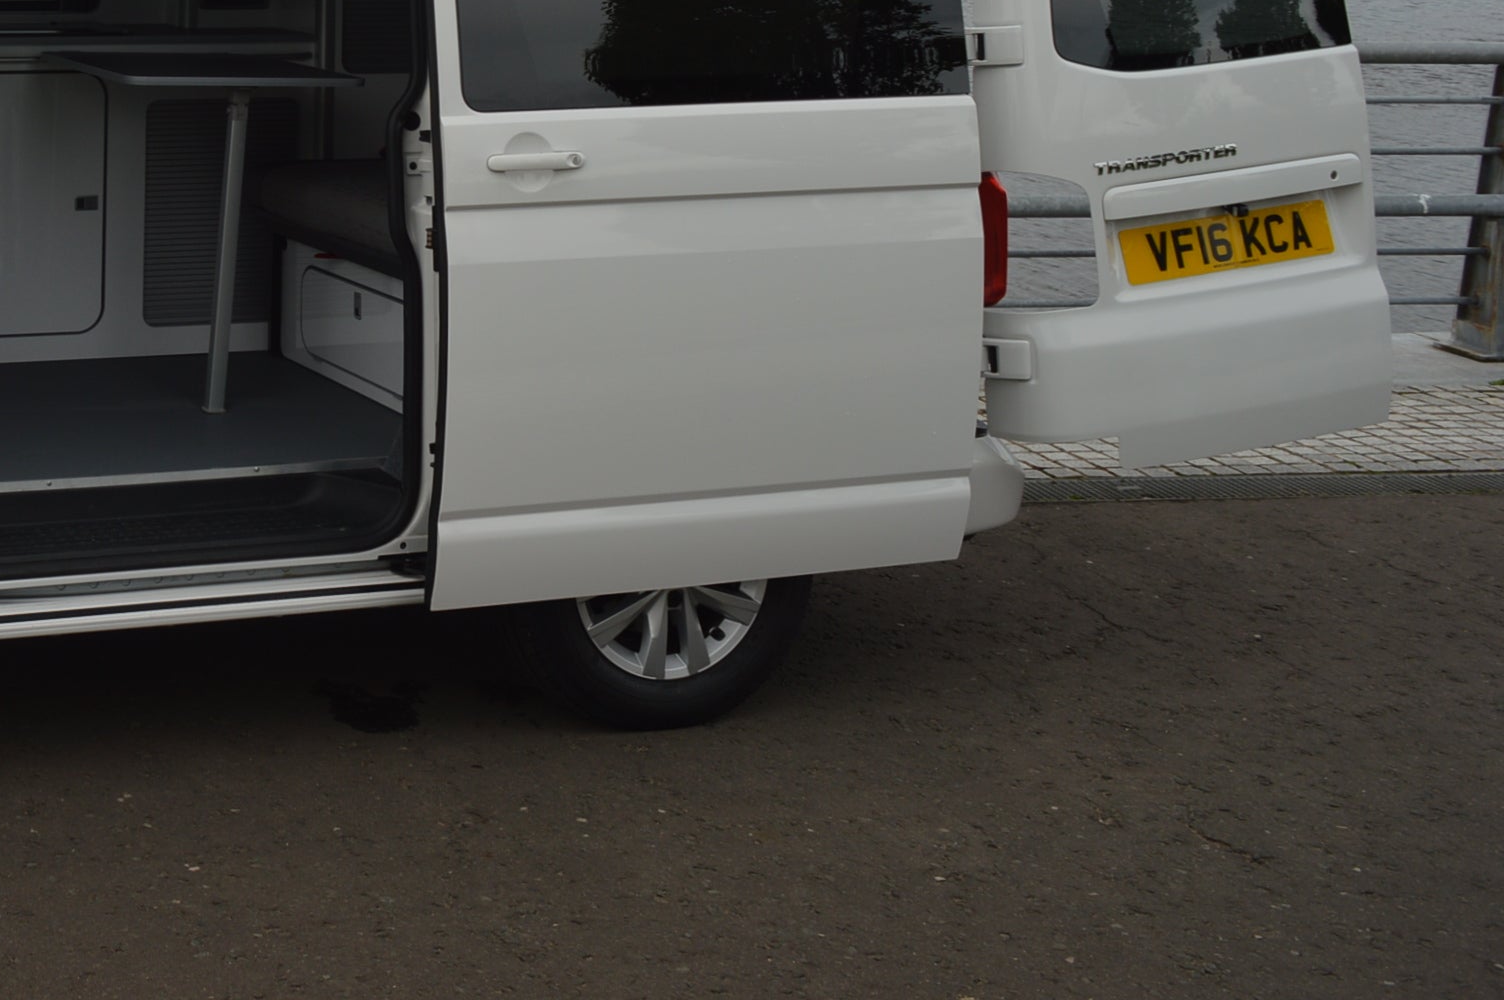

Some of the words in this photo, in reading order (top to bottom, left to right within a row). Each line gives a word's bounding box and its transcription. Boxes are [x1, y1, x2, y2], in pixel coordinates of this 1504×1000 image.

[1093, 143, 1238, 176] TRANSPORTER
[1145, 223, 1234, 273] VF16
[1239, 211, 1313, 259] KCA
